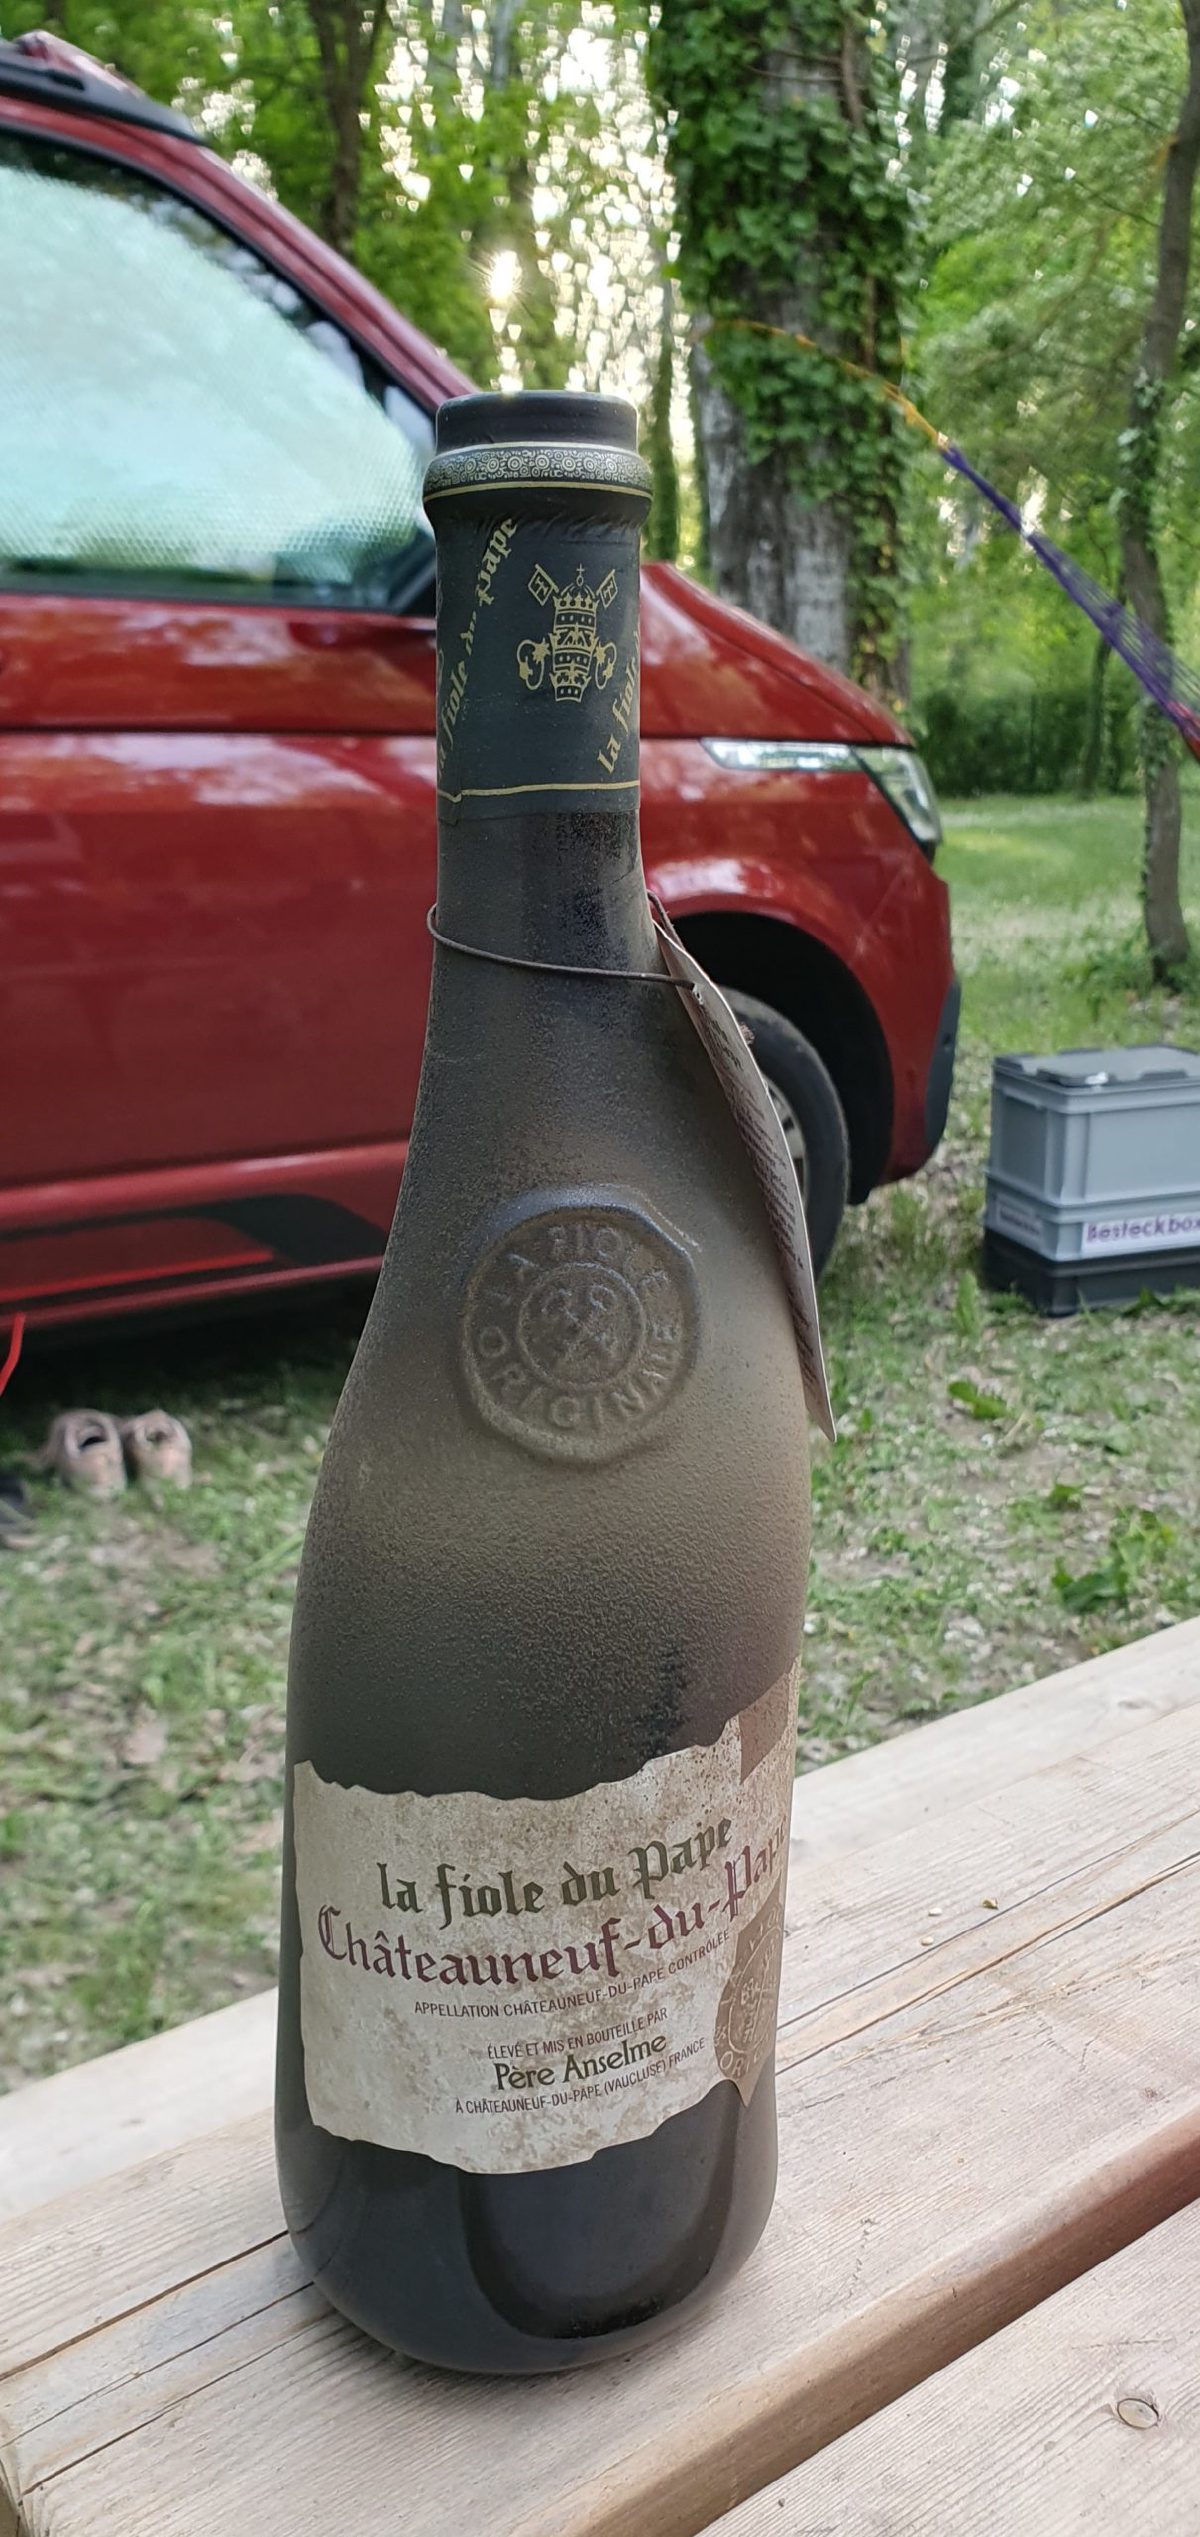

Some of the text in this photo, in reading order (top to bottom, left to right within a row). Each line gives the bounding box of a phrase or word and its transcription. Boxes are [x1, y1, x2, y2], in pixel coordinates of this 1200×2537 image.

[548, 1222, 675, 1302] FIOLE
[478, 1318, 683, 1432] ORIGINALE
[376, 1817, 733, 1931] la fiole du Pape
[414, 2000, 500, 2018] APPELLATION
[503, 1967, 666, 2018] CHÂTEAUNEUF-DU-PAPE
[487, 2006, 669, 2060] ÉLEVÉ ET MIS EN BOUTEILLE PAR
[493, 2034, 668, 2091] Père Anselme
[465, 2083, 602, 2114] CHÂTEAUNEUF-DU-PAPE
[603, 2059, 667, 2098] (VAUCLUSE)
[667, 2036, 707, 2069] FRANCE
